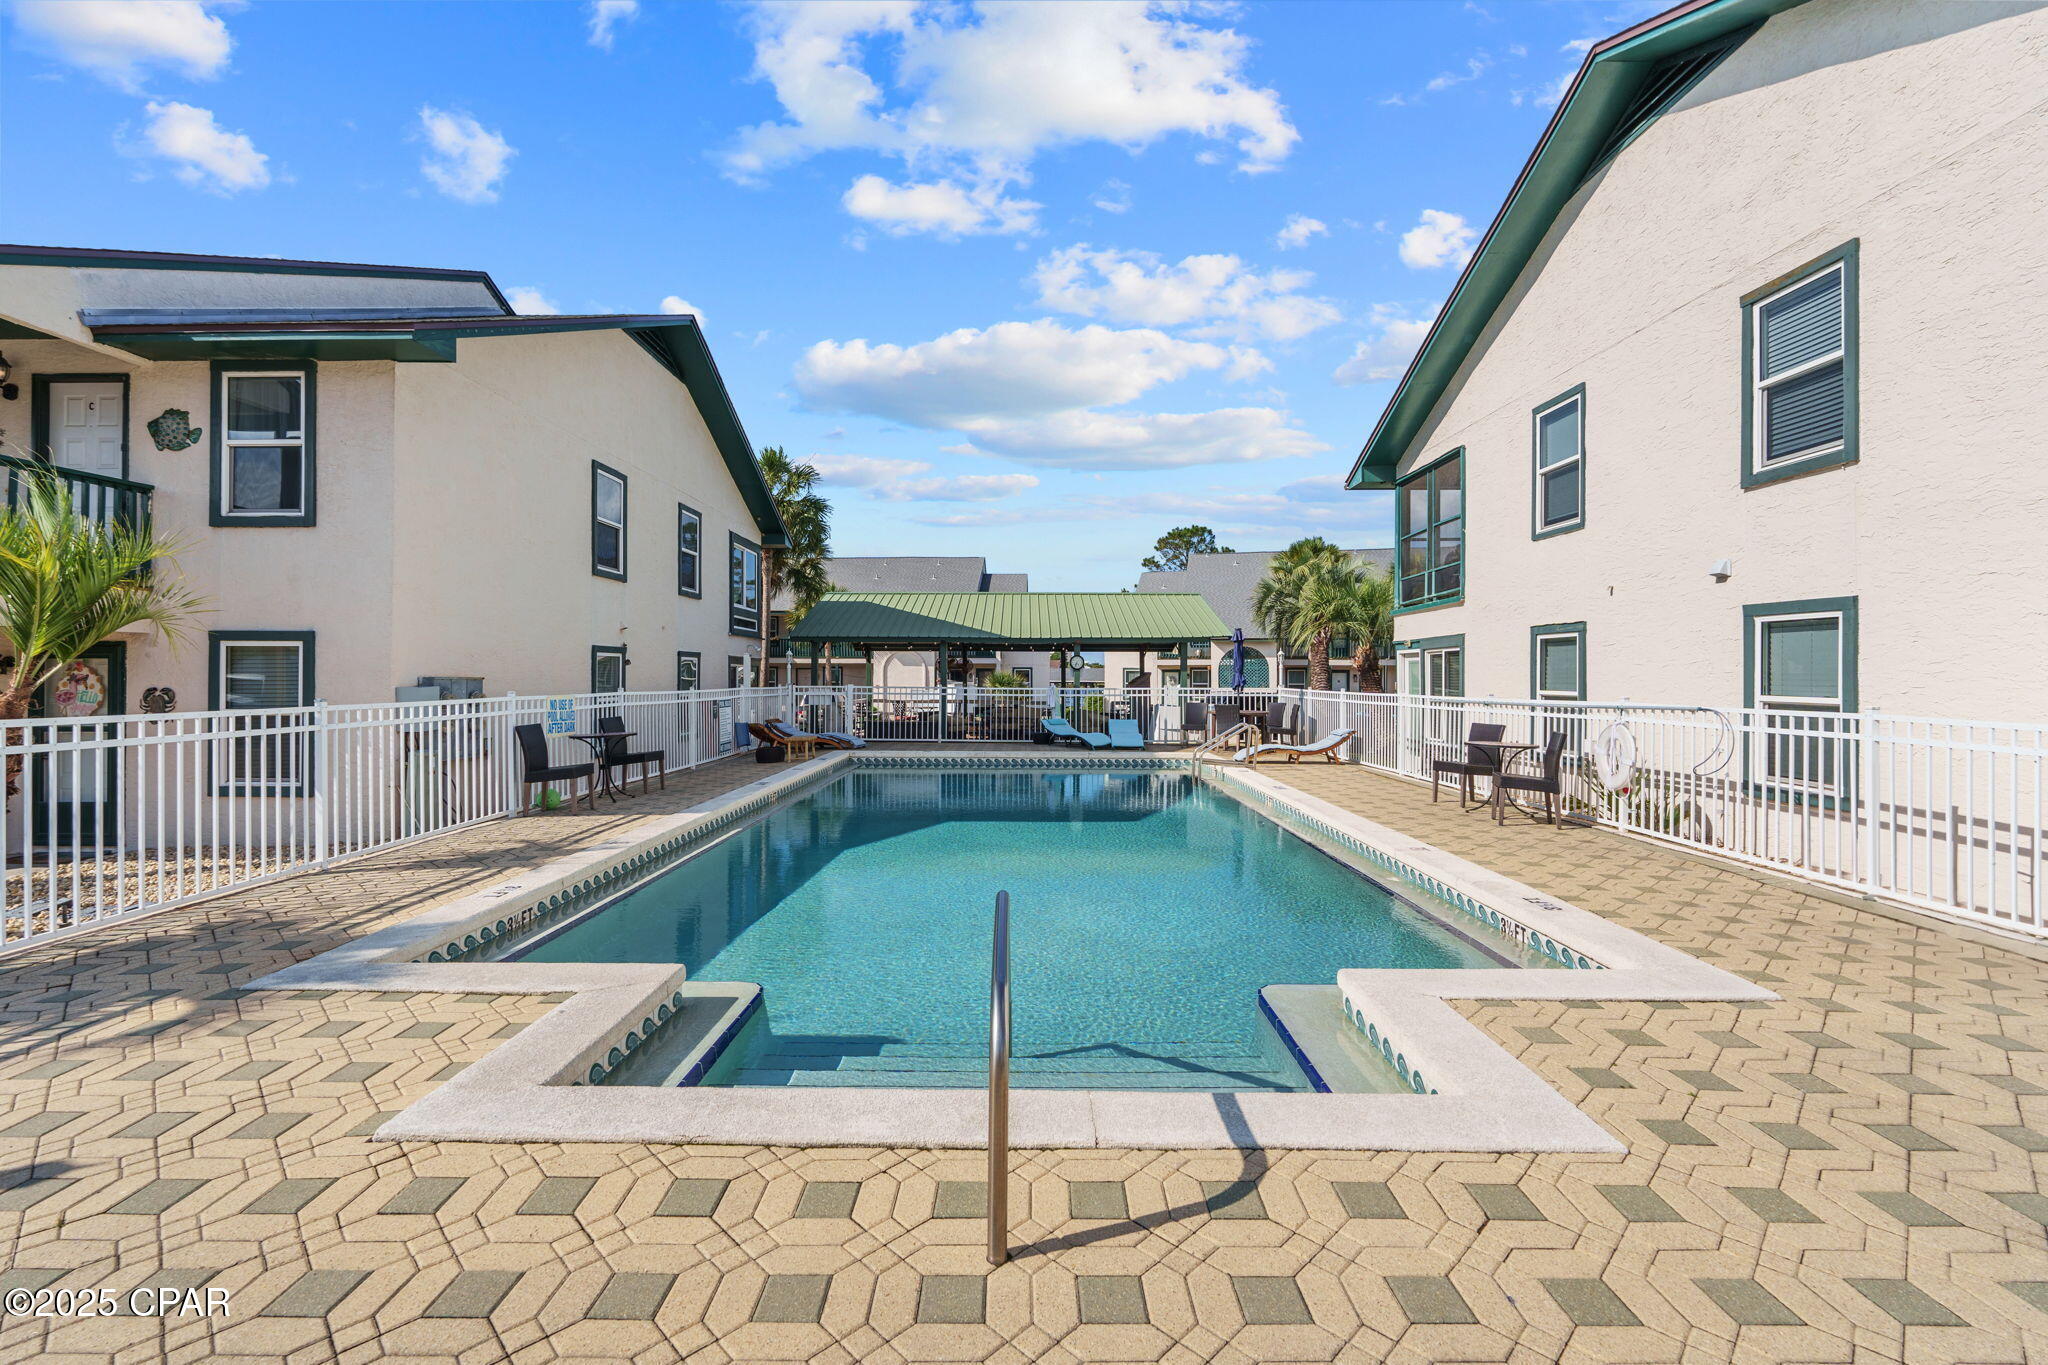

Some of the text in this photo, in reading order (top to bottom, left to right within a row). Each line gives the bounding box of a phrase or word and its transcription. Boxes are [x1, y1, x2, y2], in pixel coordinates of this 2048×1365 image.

[89, 402, 95, 411] C
[549, 698, 573, 710] NO USE OF
[547, 711, 559, 722] POOL
[547, 722, 576, 734] AFTER DARK
